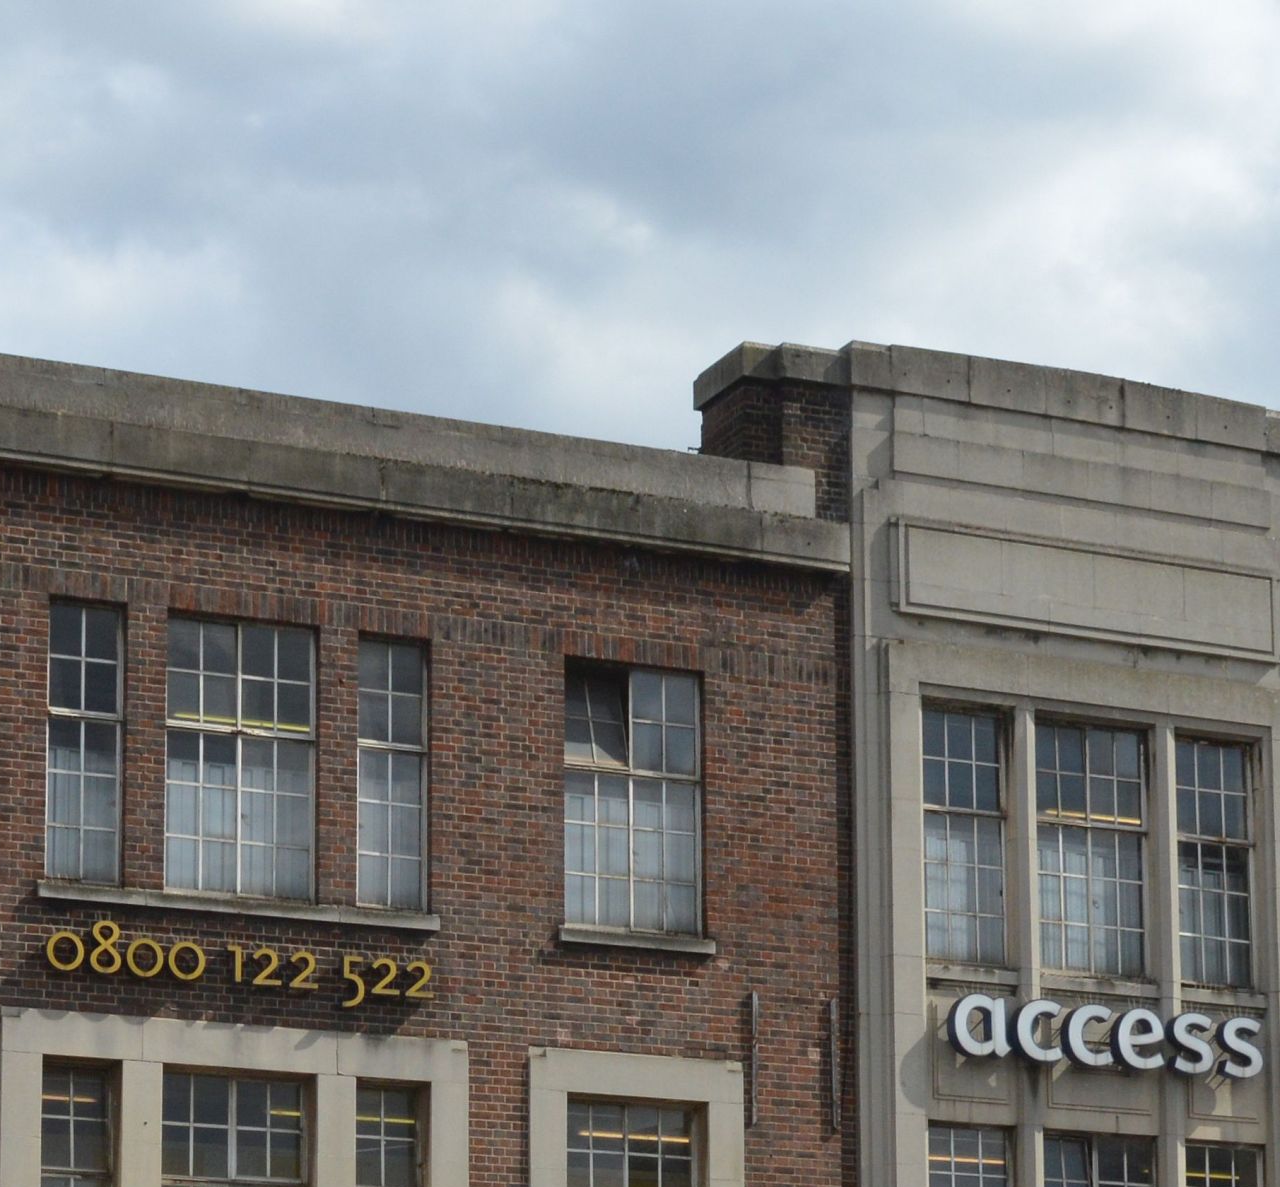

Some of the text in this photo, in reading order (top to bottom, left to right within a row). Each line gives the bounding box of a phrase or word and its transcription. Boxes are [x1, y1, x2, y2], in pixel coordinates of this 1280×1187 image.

[46, 920, 435, 1008] 0800 122 522
[950, 993, 1265, 1079] access
